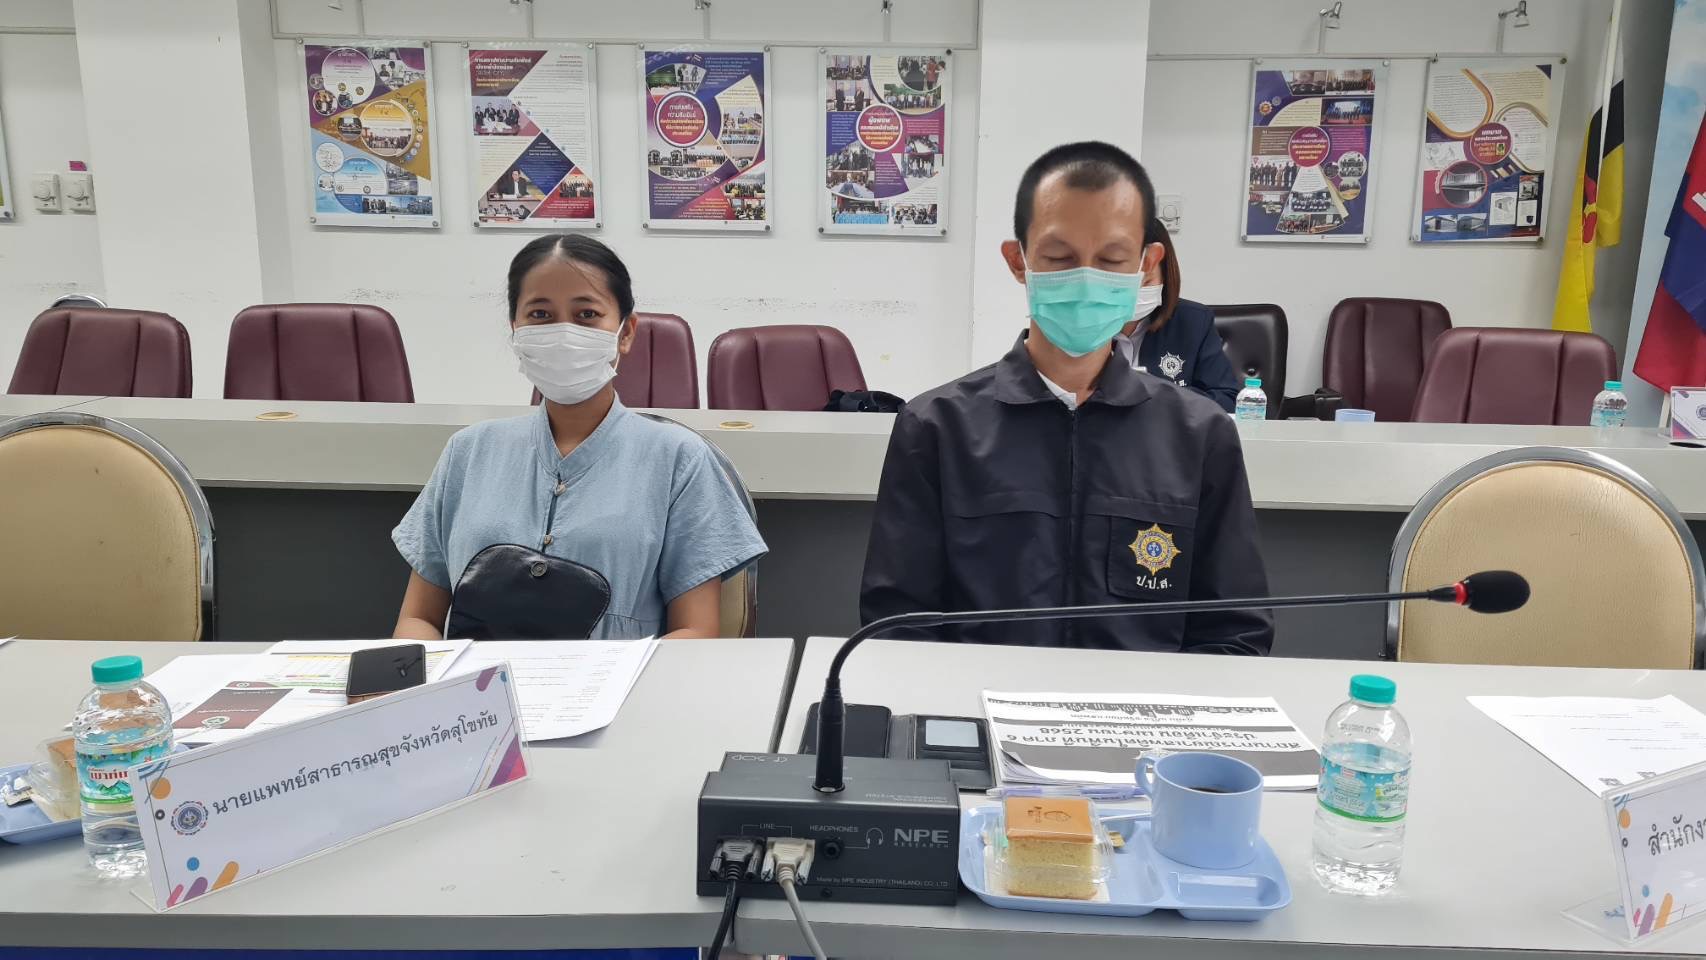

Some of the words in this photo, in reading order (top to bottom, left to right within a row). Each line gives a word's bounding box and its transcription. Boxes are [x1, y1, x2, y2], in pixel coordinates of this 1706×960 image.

[1136, 575, 1173, 590] ป.ป.ส.
[1006, 733, 1016, 743] 6
[1039, 726, 1083, 736] 2568
[1087, 727, 1154, 738] เมษายน
[1159, 725, 1255, 743] ประจำเดือน
[1023, 734, 1057, 748] ภาค
[212, 708, 499, 815] นายแพทย์สาธารณสุขจังหวัดสุโขทัย
[810, 825, 859, 833] HEADPHONES
[893, 828, 949, 844] NPE
